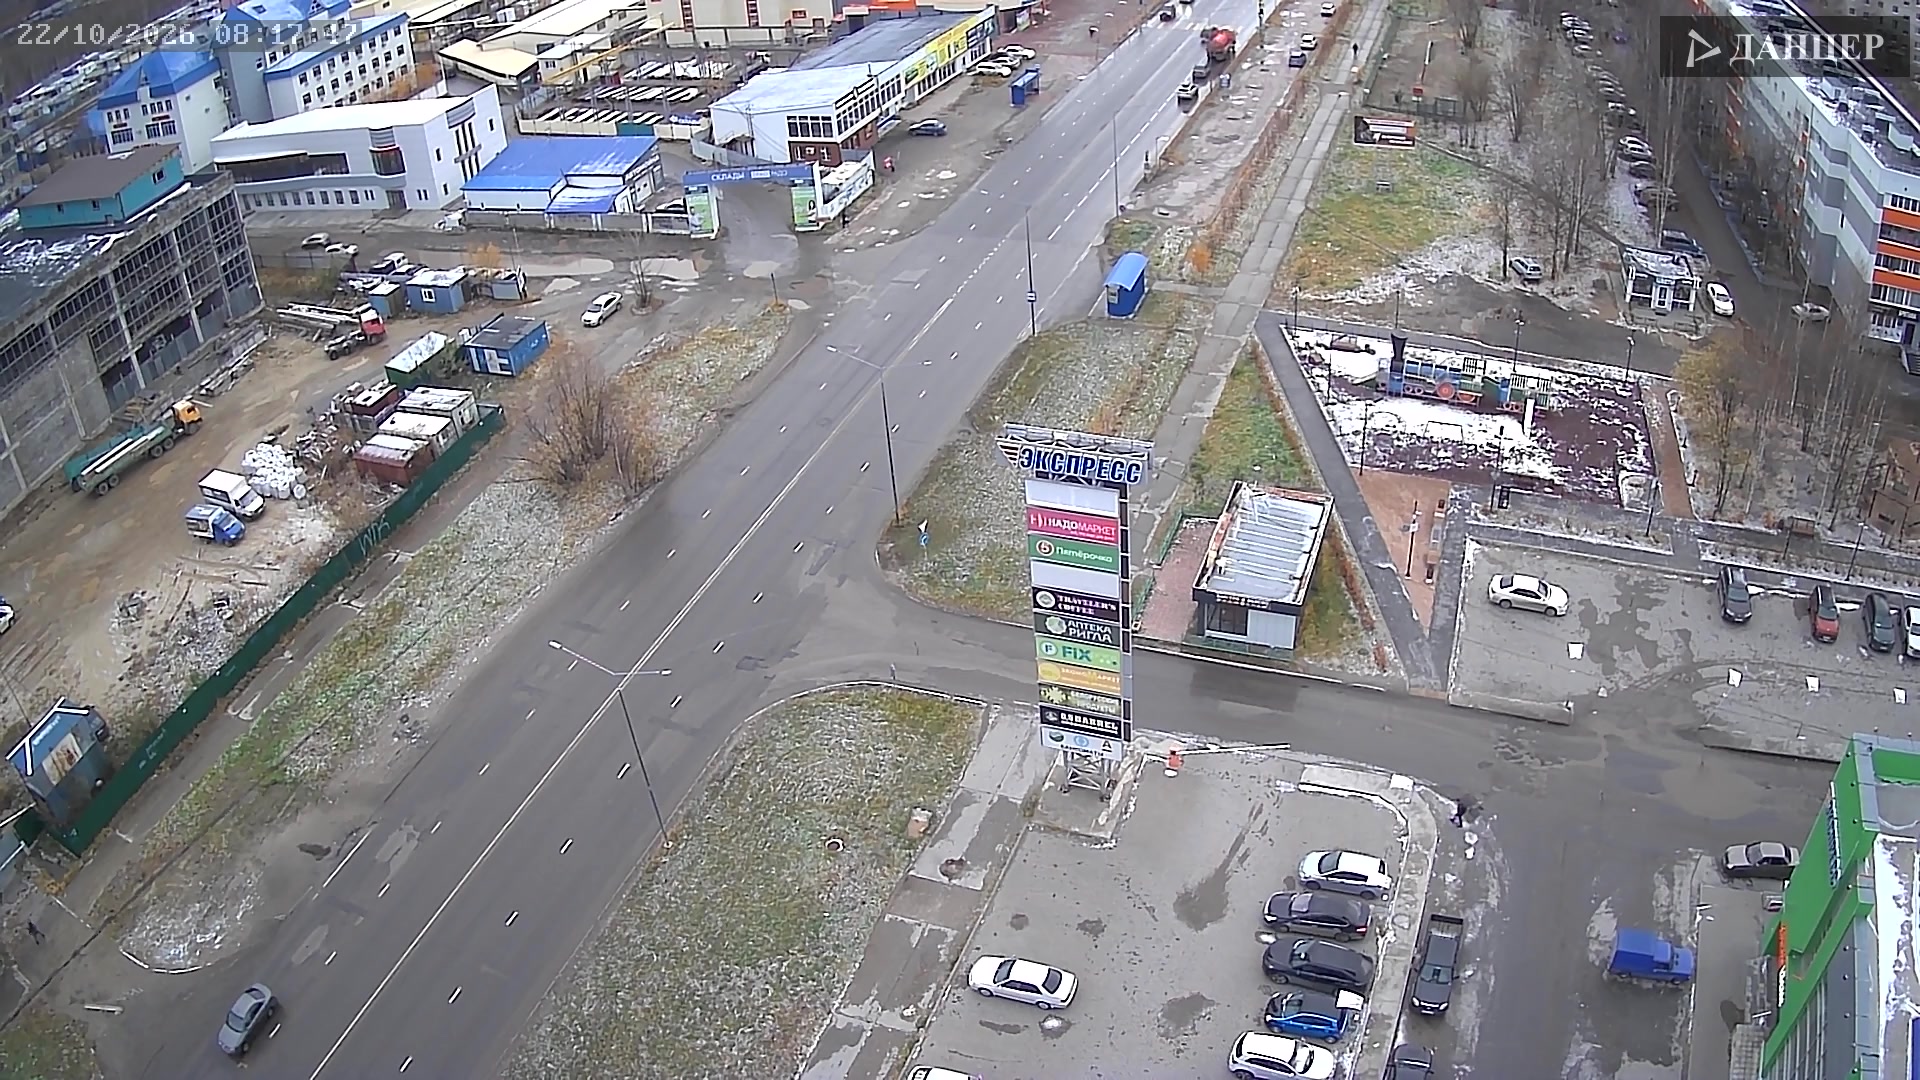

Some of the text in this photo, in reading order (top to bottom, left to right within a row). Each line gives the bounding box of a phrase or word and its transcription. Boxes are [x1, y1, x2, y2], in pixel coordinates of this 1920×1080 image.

[1018, 445, 1143, 484] ЭКСПРЕСС
[1047, 516, 1116, 535] НАДОМАРКЕТ
[1067, 620, 1112, 634] АПТЕКА
[1068, 627, 1112, 643] РИГЛА
[1061, 645, 1092, 661] FIX
